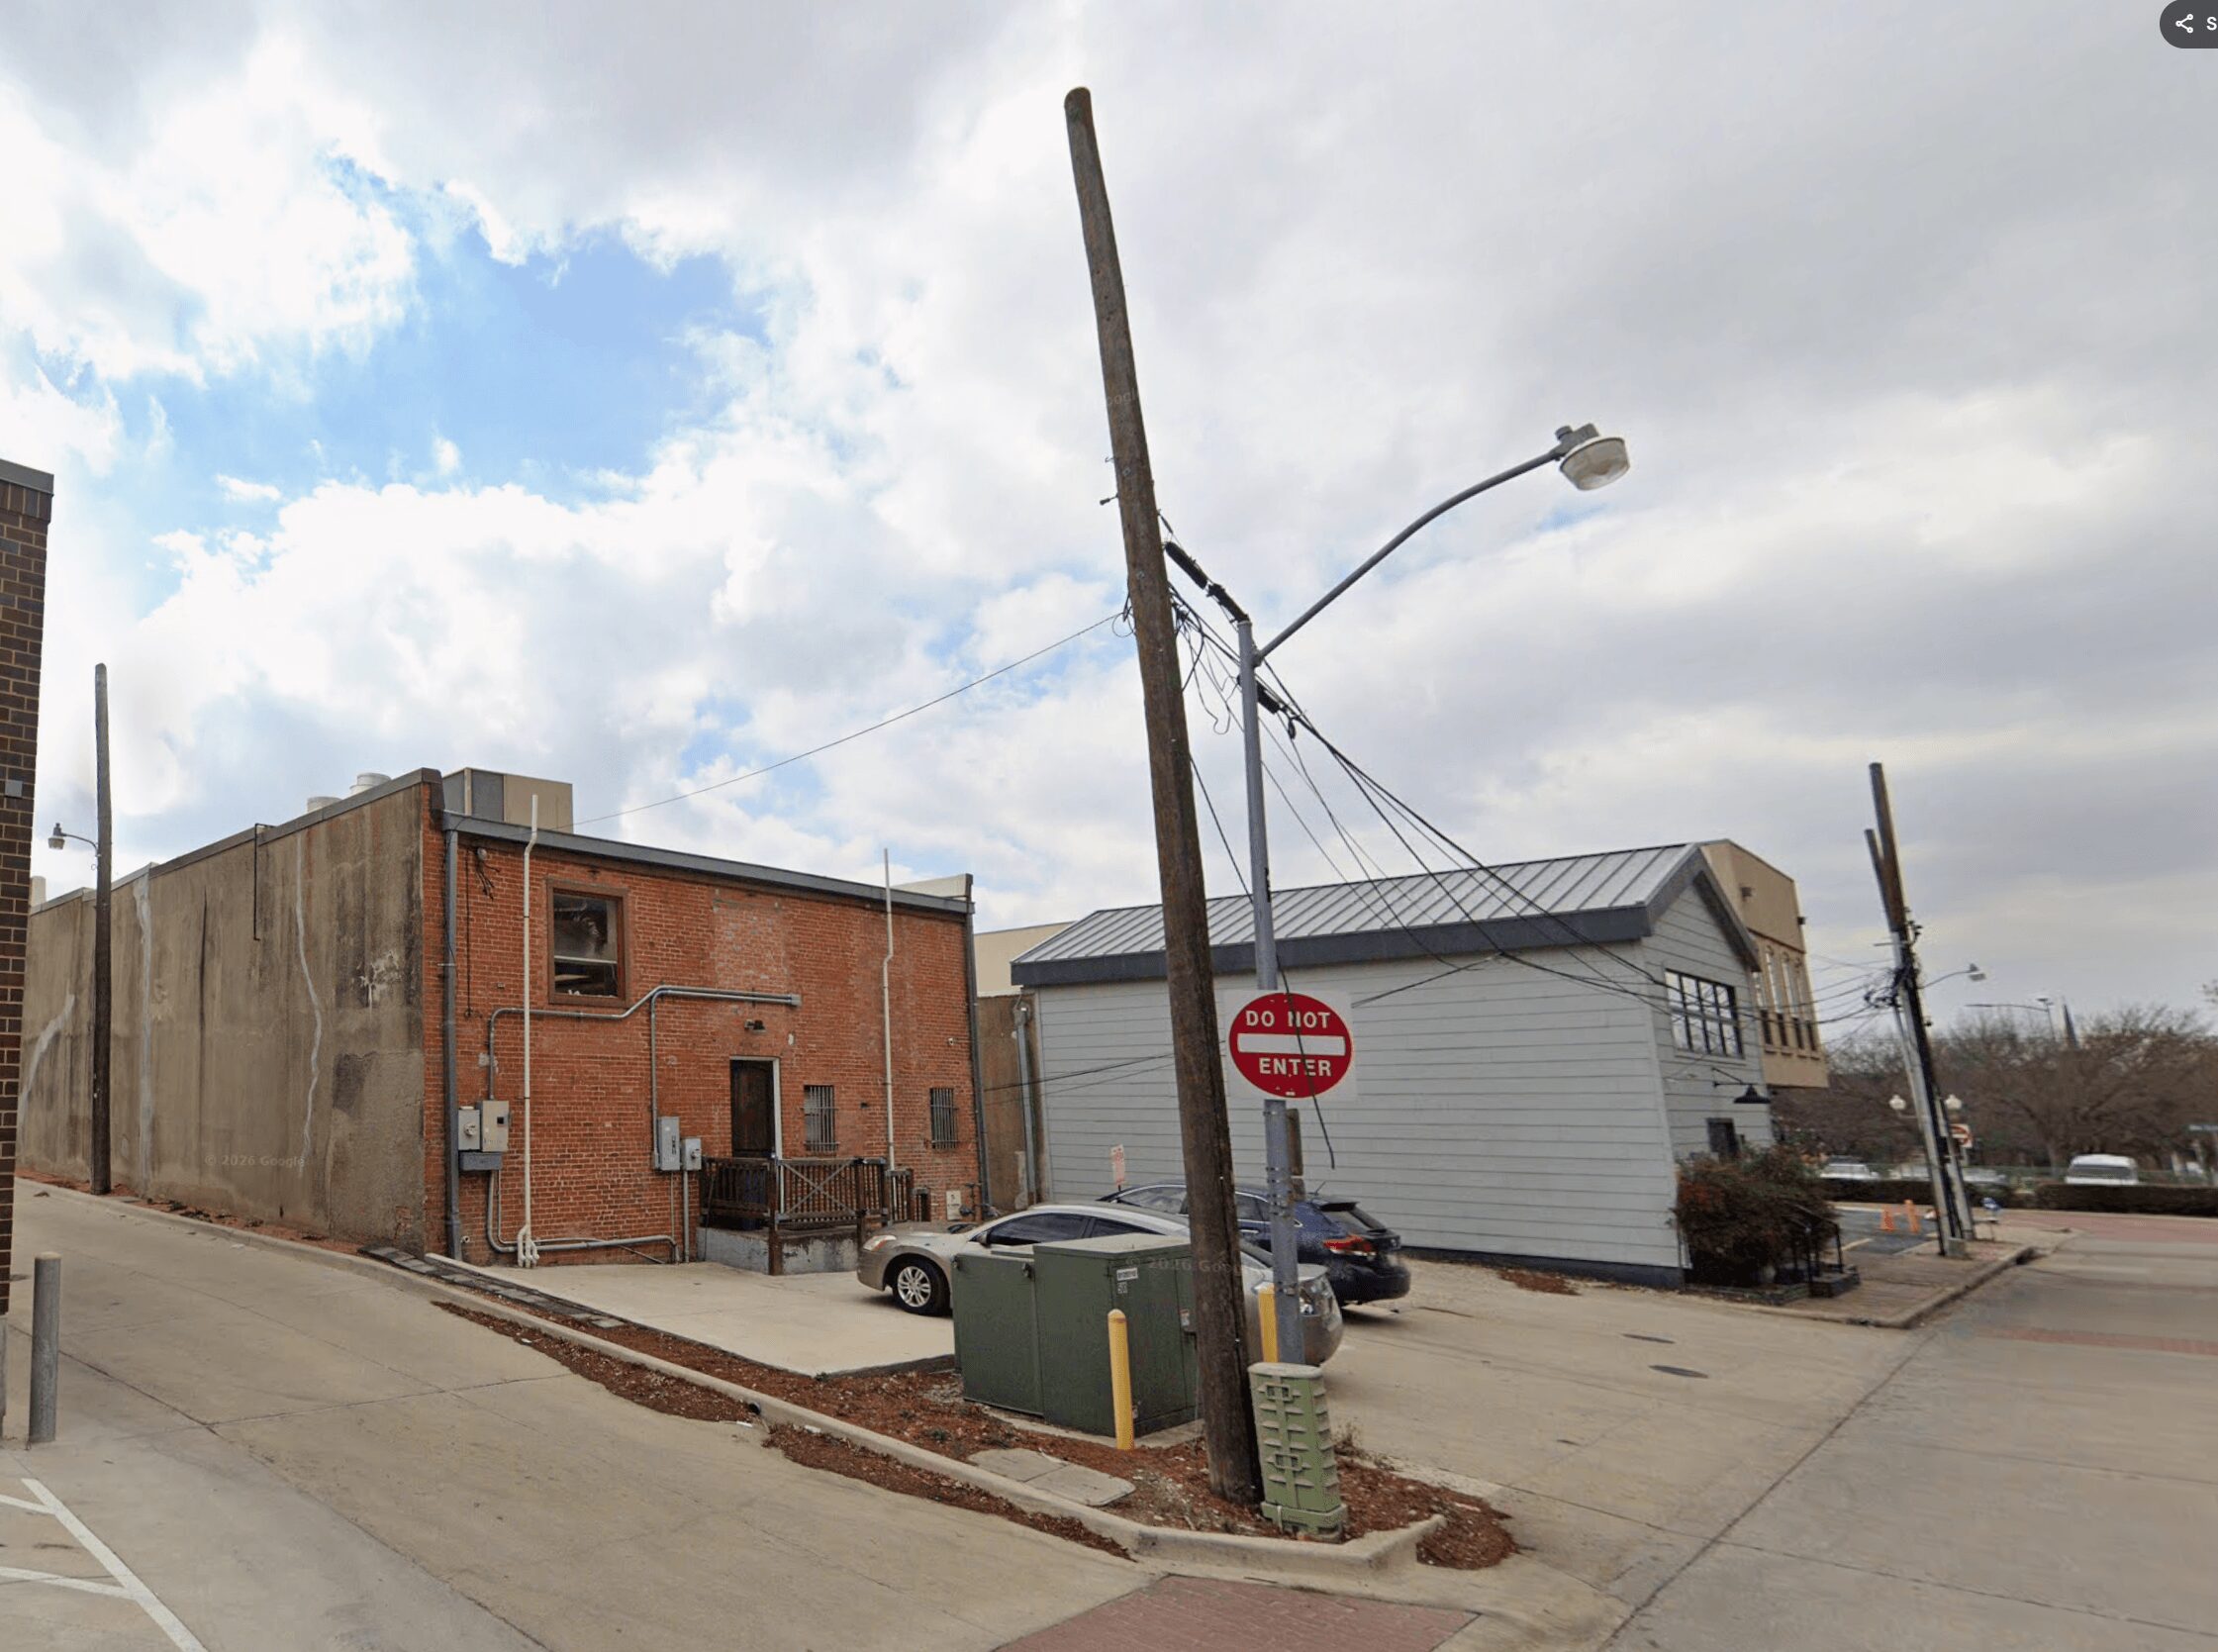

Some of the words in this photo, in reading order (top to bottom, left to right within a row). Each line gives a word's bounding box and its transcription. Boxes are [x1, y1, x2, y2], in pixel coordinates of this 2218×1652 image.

[1246, 1011, 1275, 1027] DO
[1288, 1011, 1330, 1028] NOT
[1259, 1057, 1331, 1077] ENTER
